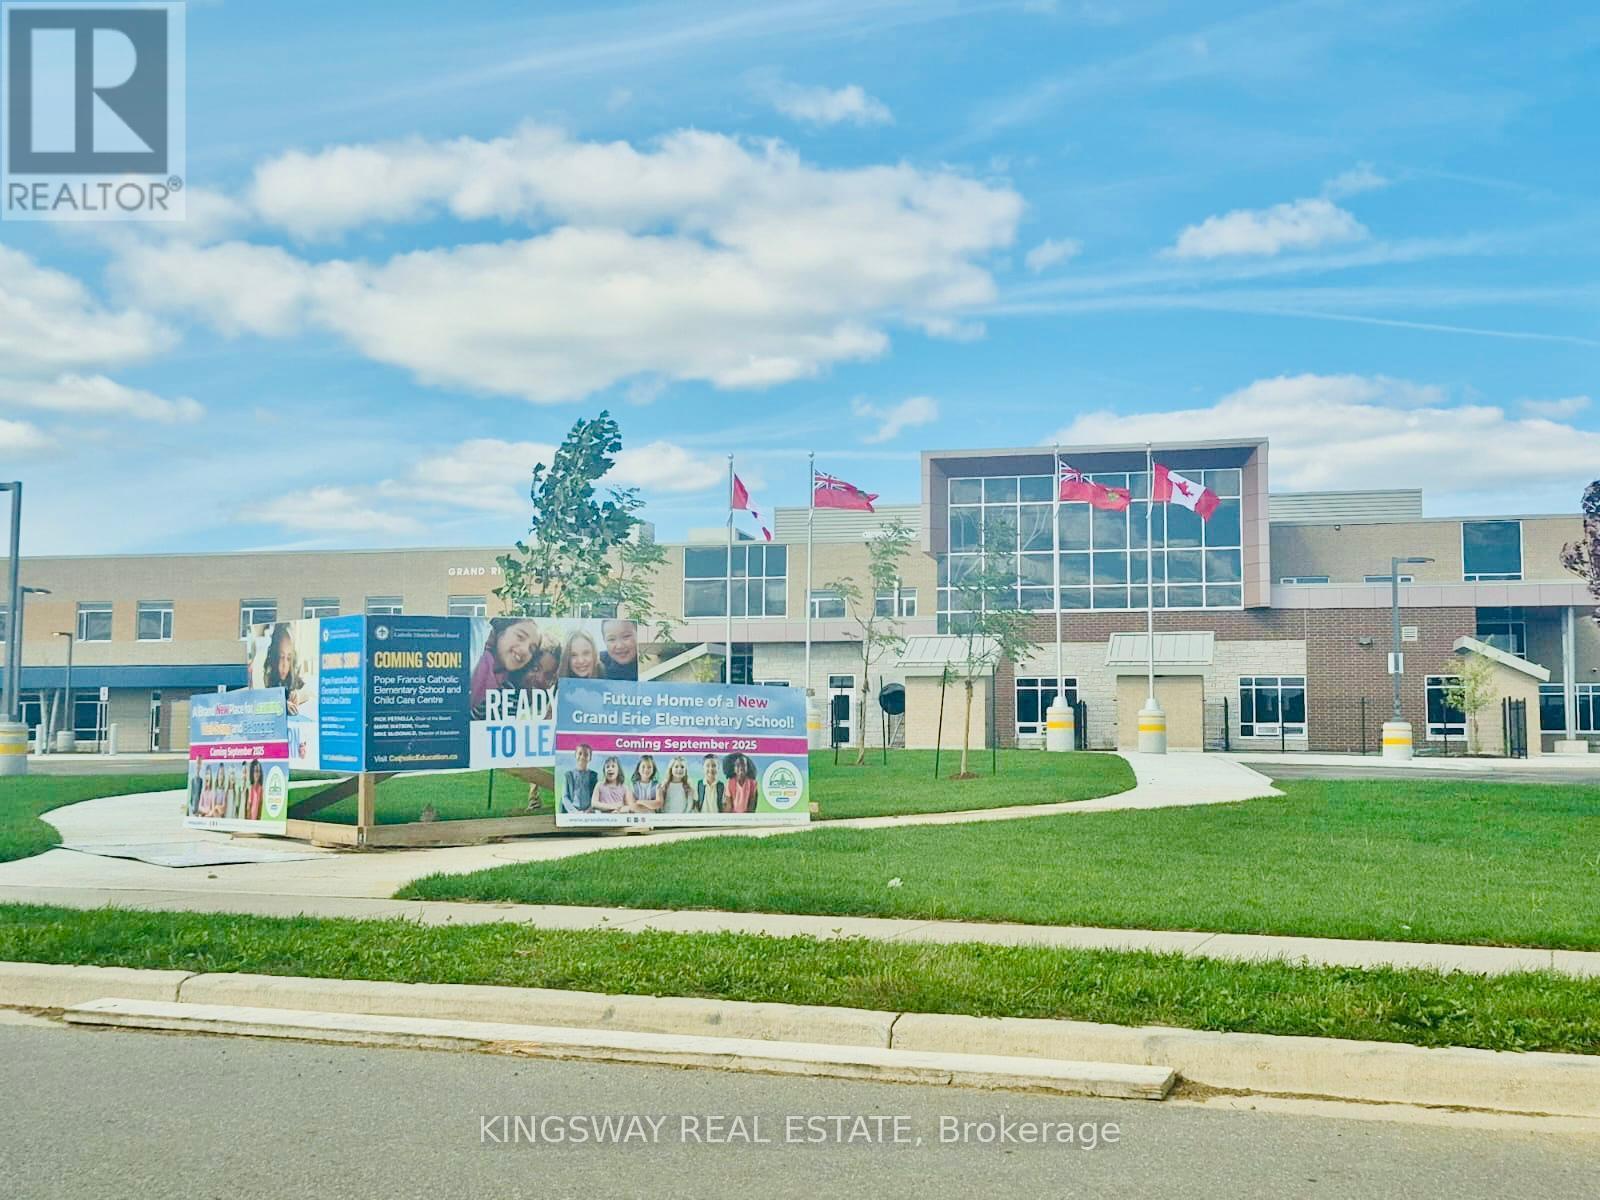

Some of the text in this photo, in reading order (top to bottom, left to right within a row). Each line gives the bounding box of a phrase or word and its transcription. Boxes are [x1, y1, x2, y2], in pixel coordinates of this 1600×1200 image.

[448, 567, 485, 576] GRAND
[374, 651, 423, 668] COMING
[426, 651, 462, 668] SOON!
[374, 675, 459, 685] Pope Francis Catholic
[374, 685, 461, 695] Elementary School and
[374, 695, 443, 704] Child Care Centre
[486, 686, 558, 720] READY
[602, 692, 769, 709] Future Home of a New
[572, 710, 794, 730] Grand Erie Elementary School!
[486, 725, 556, 758] TO LE
[616, 738, 757, 751] Coming September 2025
[209, 746, 227, 758] Coming
[227, 746, 253, 758] September
